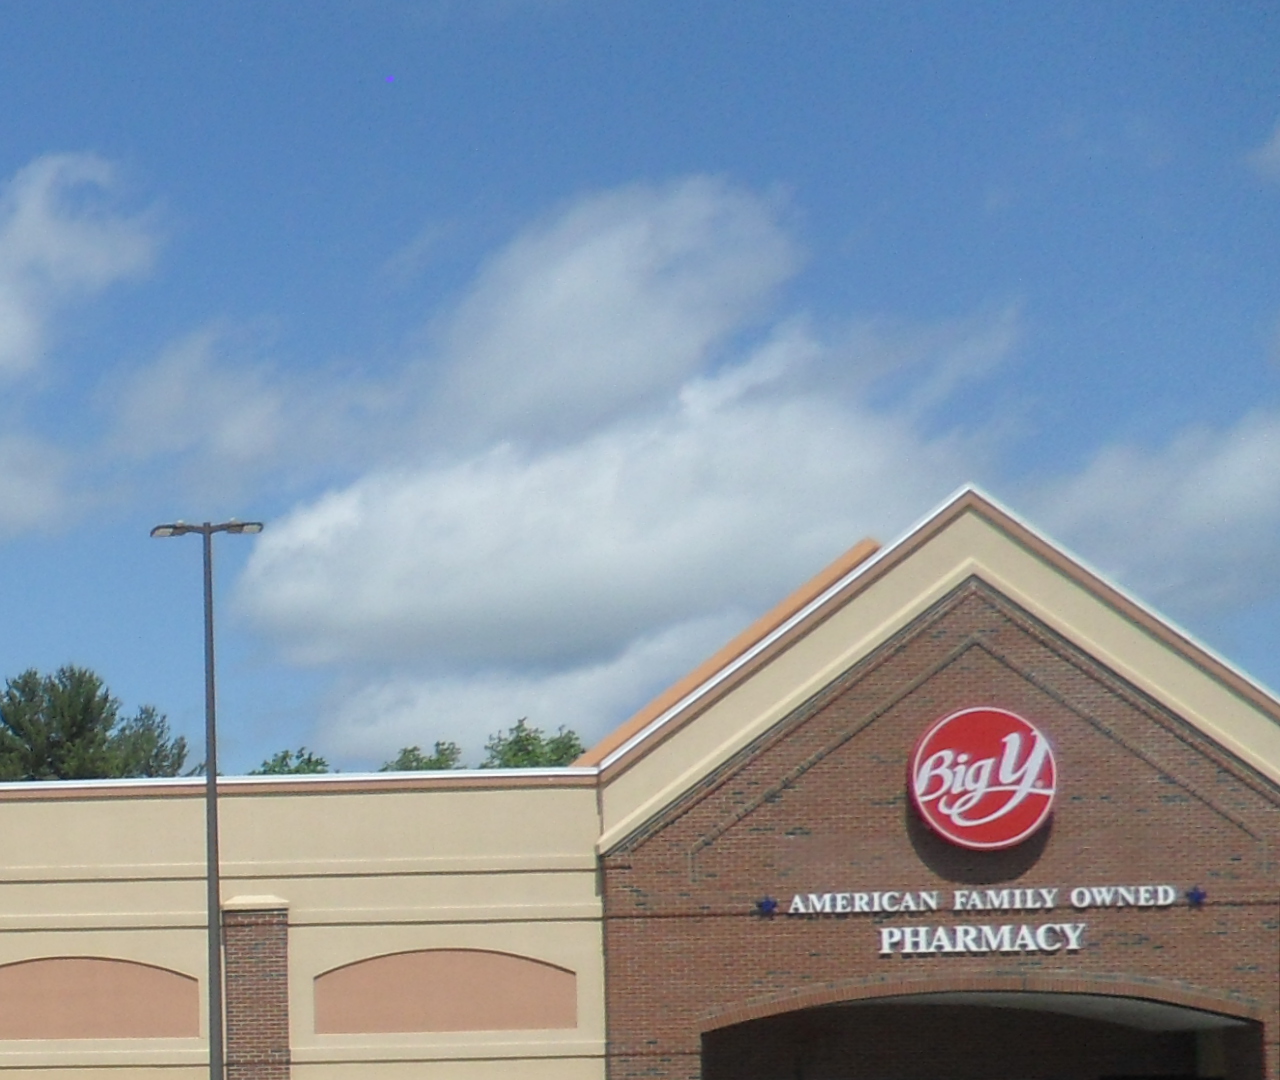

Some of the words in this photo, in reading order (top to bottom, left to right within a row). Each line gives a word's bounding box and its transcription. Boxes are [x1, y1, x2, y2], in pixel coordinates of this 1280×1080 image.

[917, 749, 996, 815] Big
[786, 891, 939, 914] AMERICAN
[952, 888, 1059, 911] FAMILY
[1070, 885, 1176, 909] OWNED
[878, 923, 1086, 954] PHARMACY
